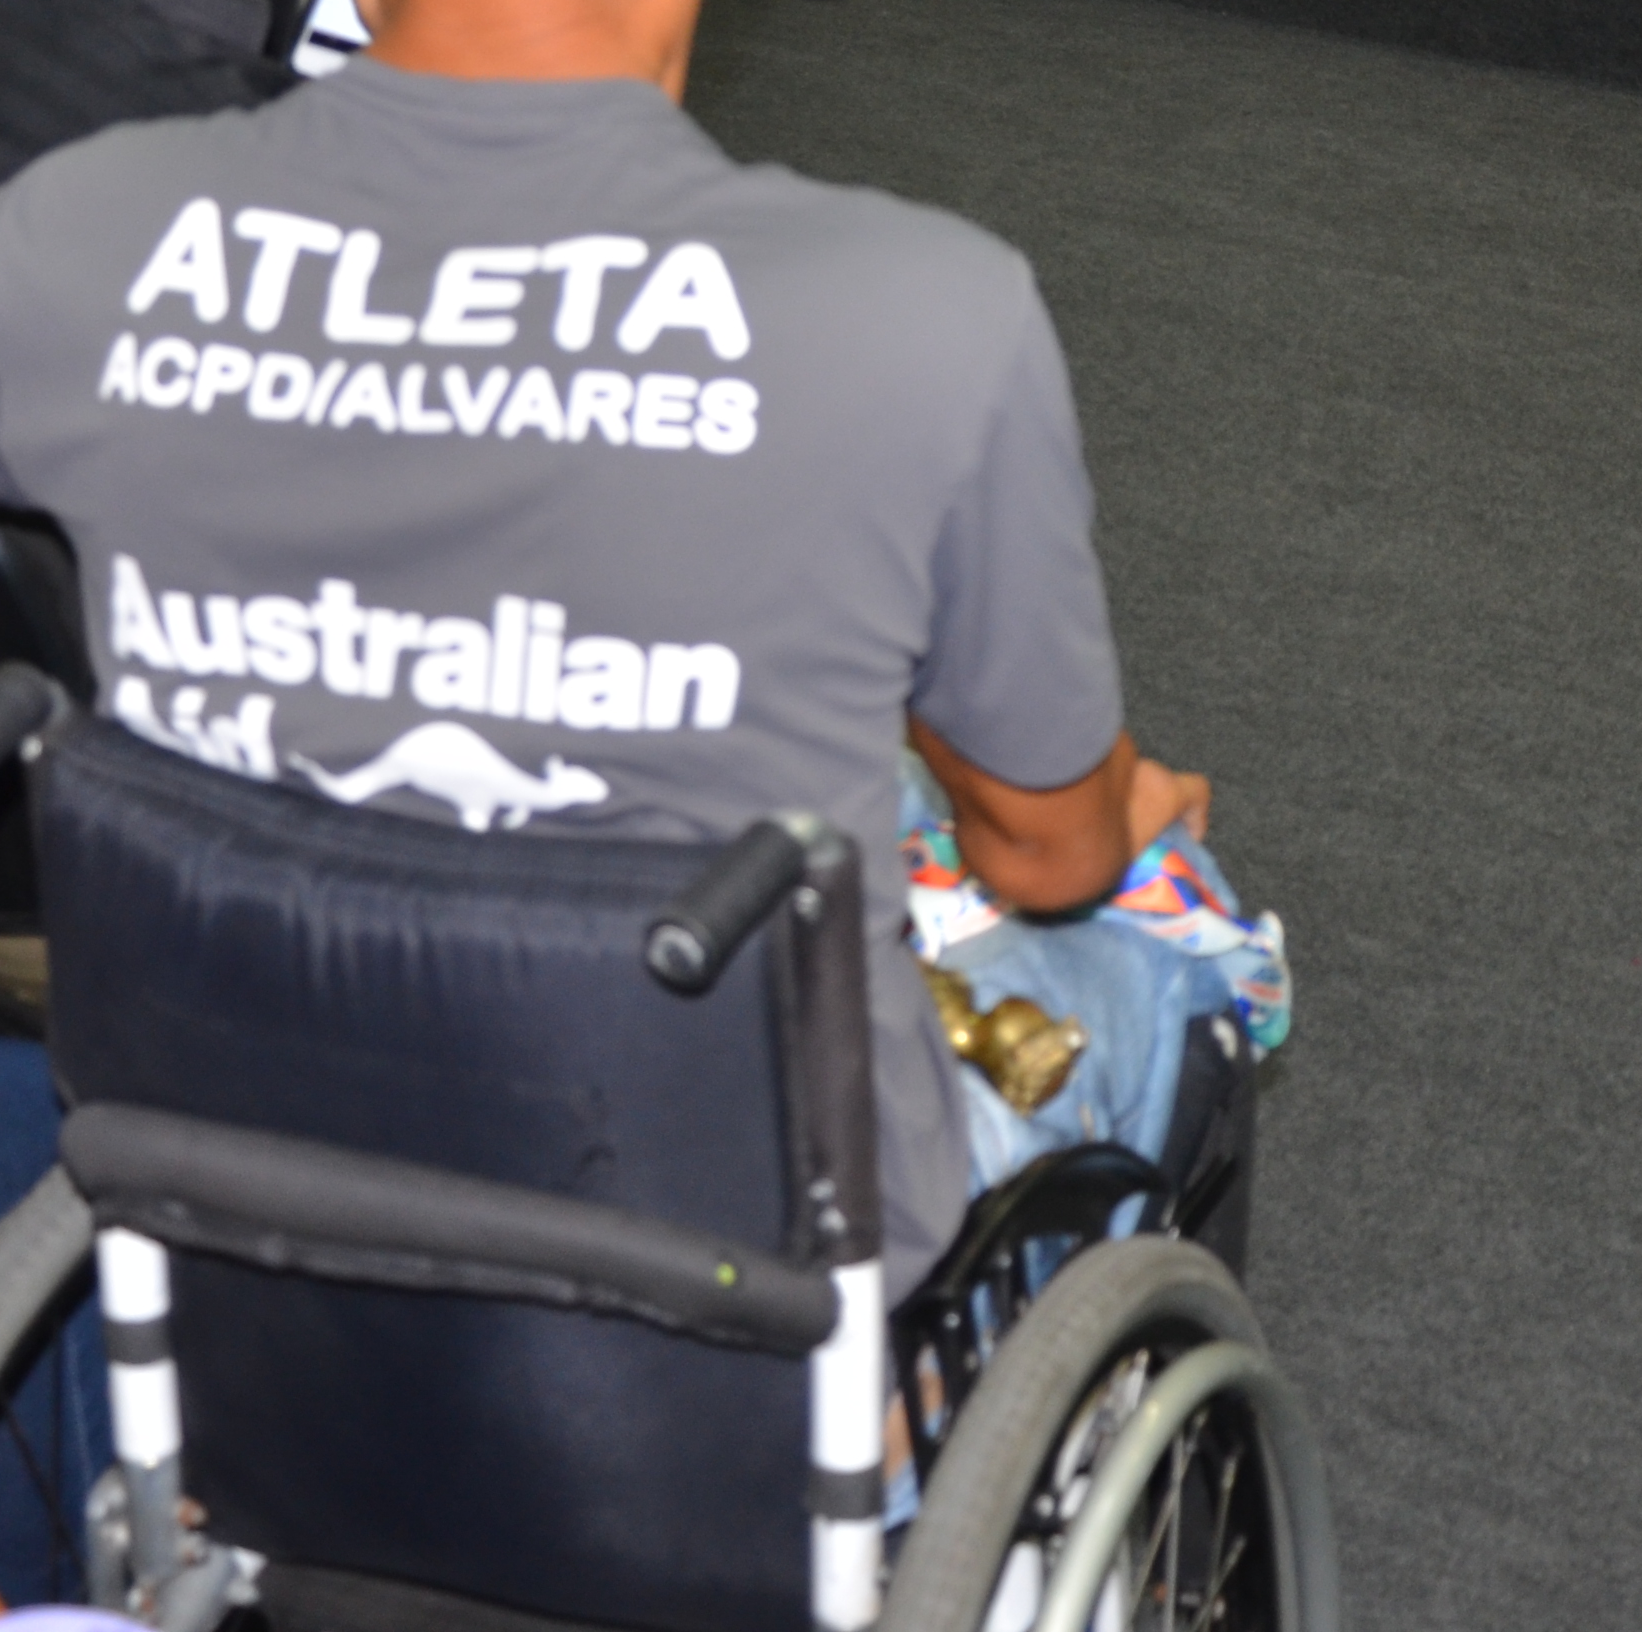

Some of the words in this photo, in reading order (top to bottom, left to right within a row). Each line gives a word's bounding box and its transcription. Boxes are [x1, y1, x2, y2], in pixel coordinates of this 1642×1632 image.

[126, 197, 753, 362] ATLETA
[99, 332, 760, 455] ACPD/ALVARES
[112, 555, 742, 731] Australian
